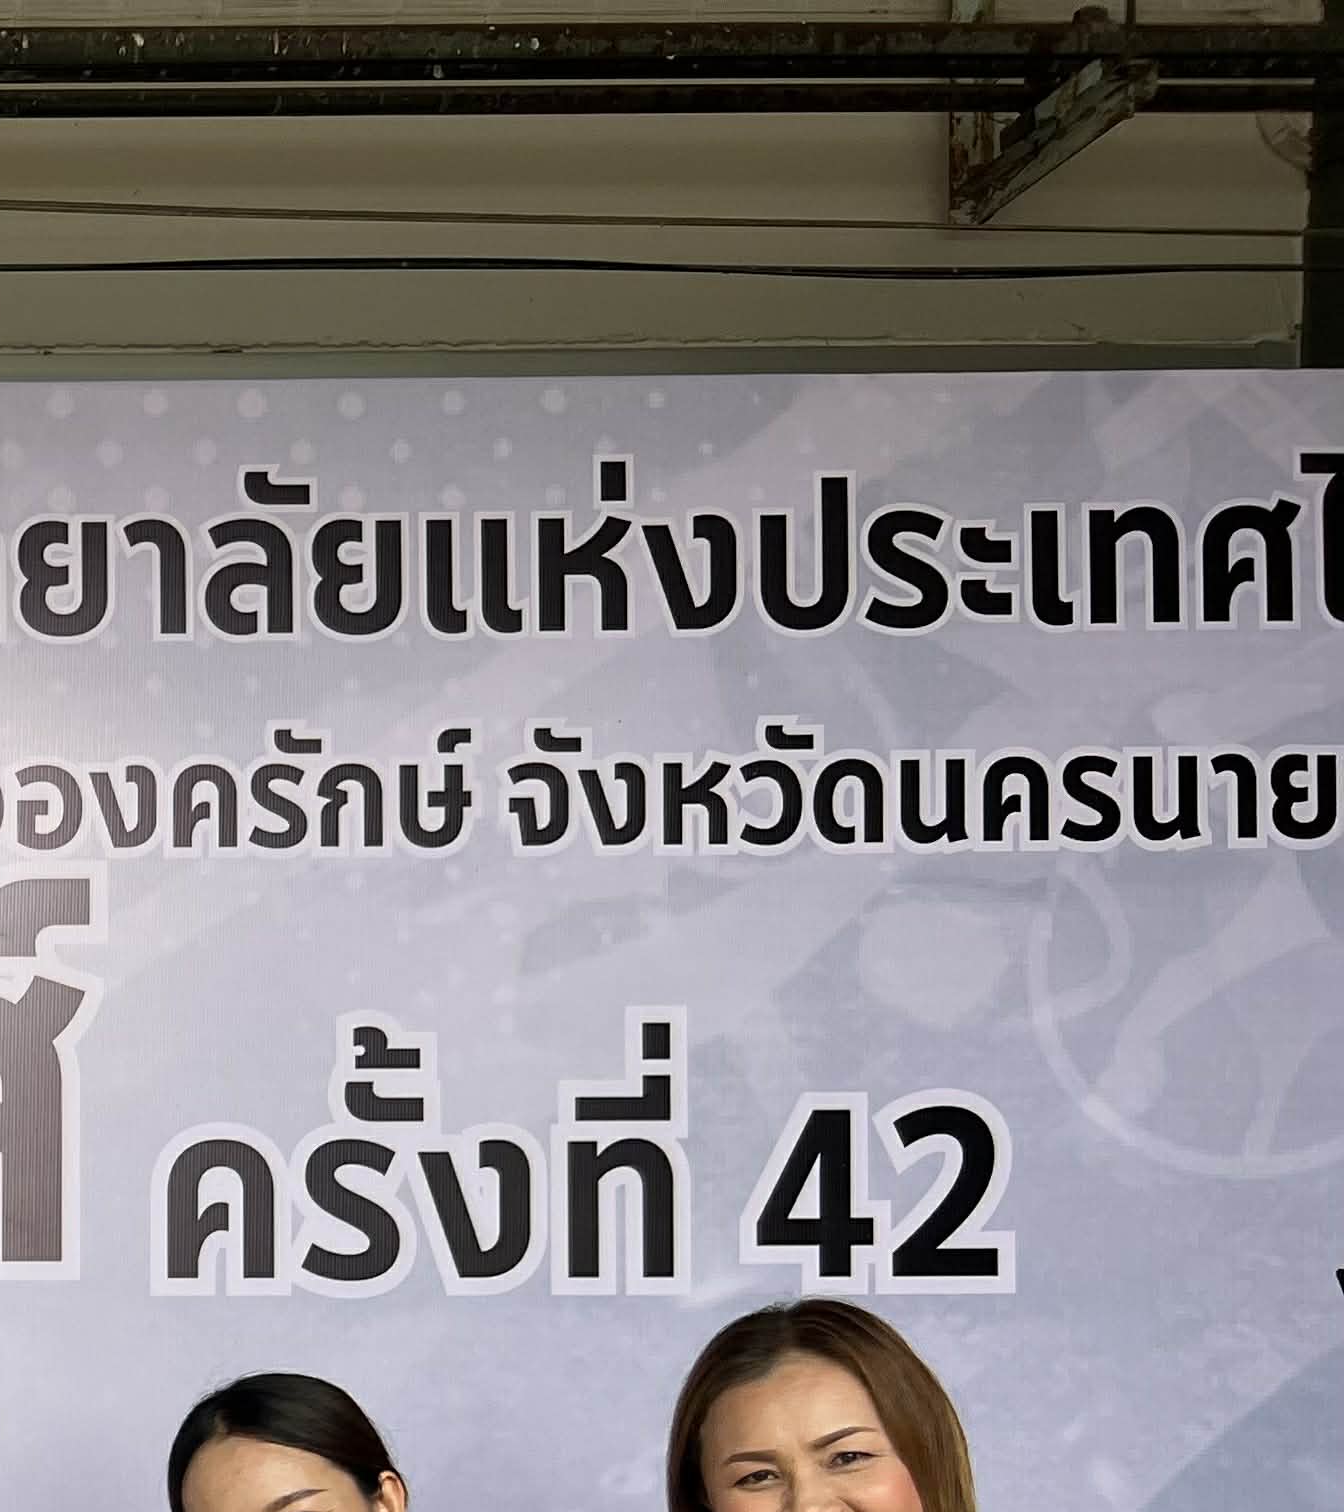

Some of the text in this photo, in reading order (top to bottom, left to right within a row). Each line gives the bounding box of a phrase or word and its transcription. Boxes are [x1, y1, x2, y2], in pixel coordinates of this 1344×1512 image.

[508, 724, 1338, 846] จังหวัดนครนาย
[165, 1021, 1001, 1282] ครั้งที่ 42
